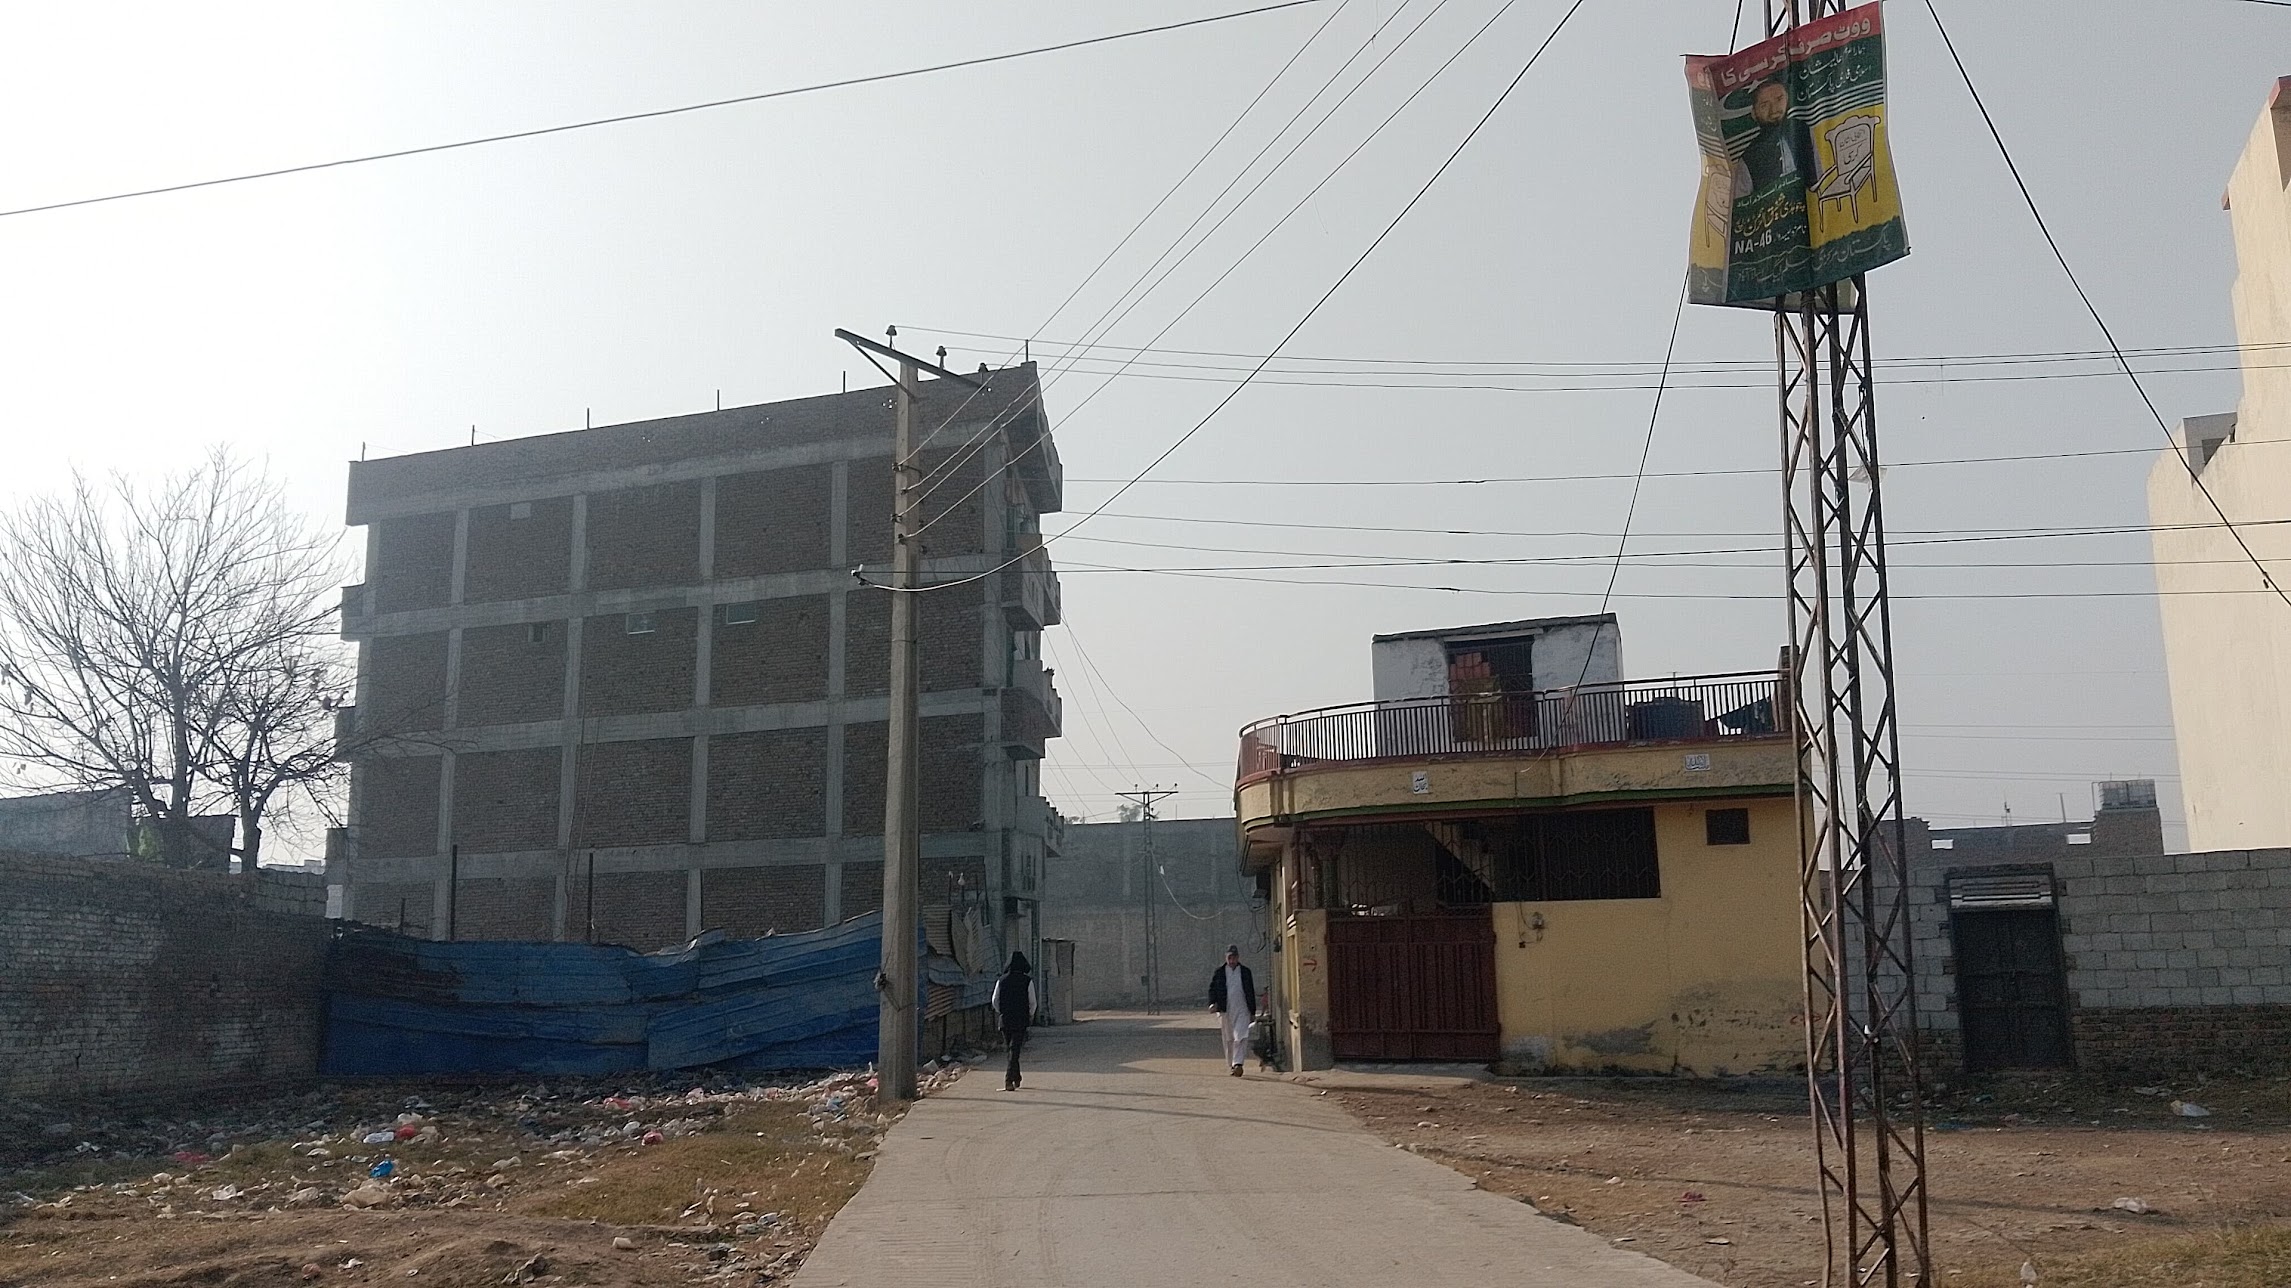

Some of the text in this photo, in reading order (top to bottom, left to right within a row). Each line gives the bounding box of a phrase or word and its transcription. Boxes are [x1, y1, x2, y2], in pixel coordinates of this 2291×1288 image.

[1833, 17, 1871, 41] ووٹ
[1787, 31, 1832, 55] صرف
[1738, 44, 1787, 82] کرسی
[1720, 66, 1737, 88] کا
[1796, 70, 1836, 101] پاکستان
[1735, 229, 1773, 255] NA-46
[1837, 224, 1890, 264] پاکستان
